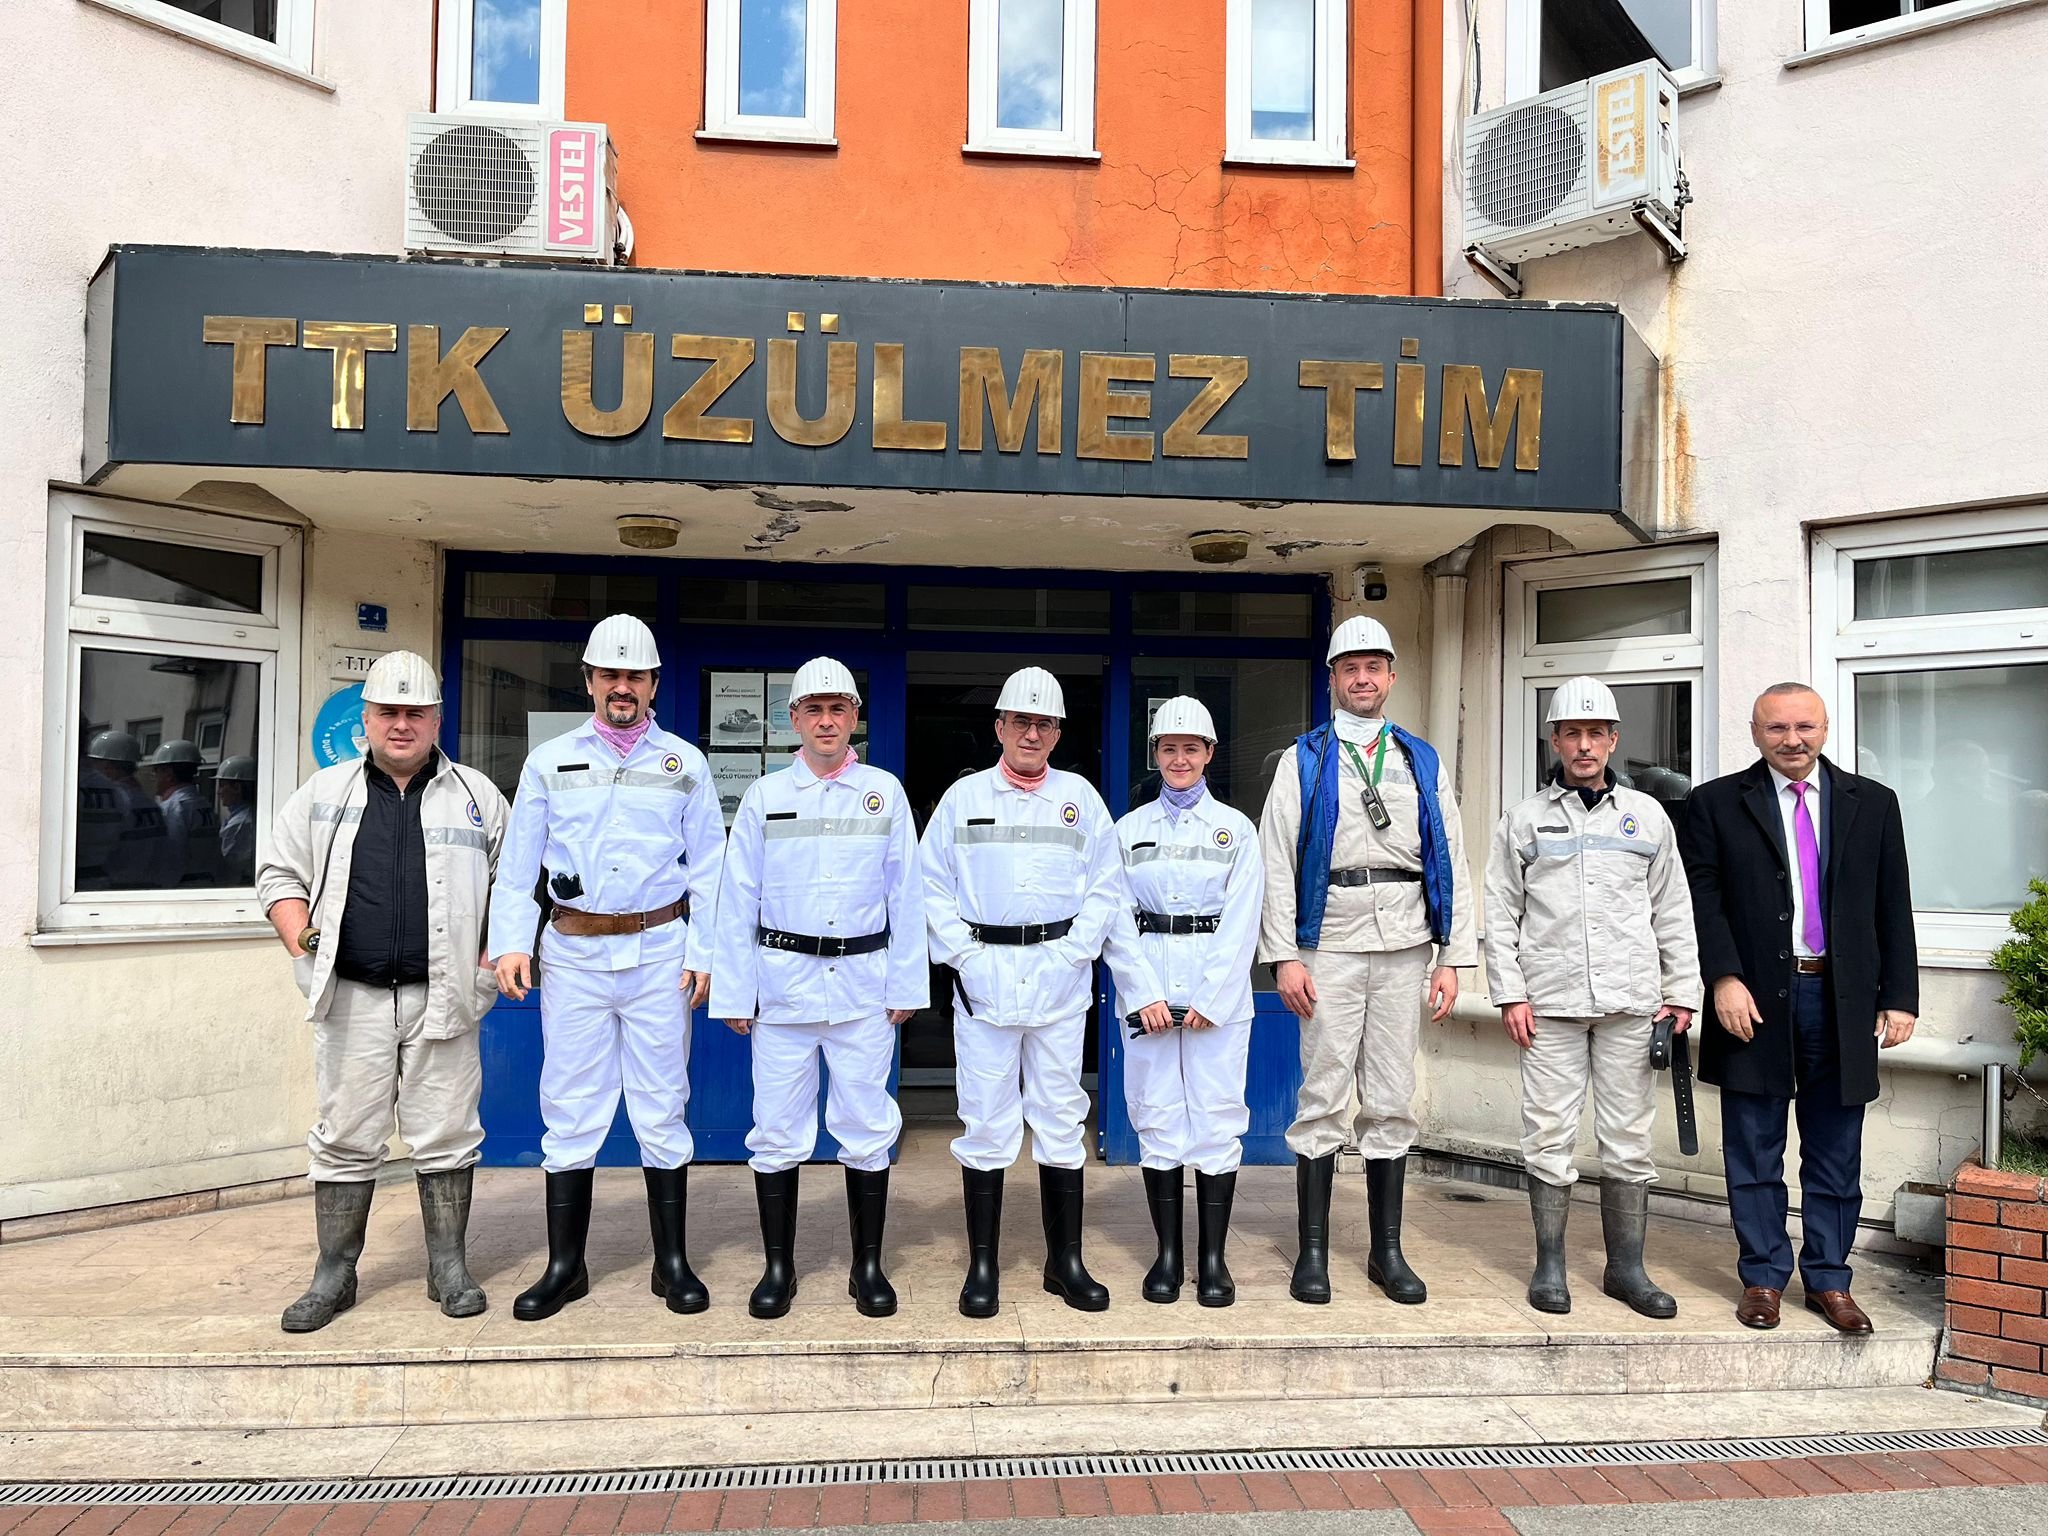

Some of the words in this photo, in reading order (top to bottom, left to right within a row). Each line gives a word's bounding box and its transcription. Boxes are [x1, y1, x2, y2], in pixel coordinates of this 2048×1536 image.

[560, 133, 585, 242] VESTEL
[203, 315, 511, 434] TTK
[561, 303, 1248, 462] ÜZÜLMEZ
[1299, 337, 1543, 471] TİM
